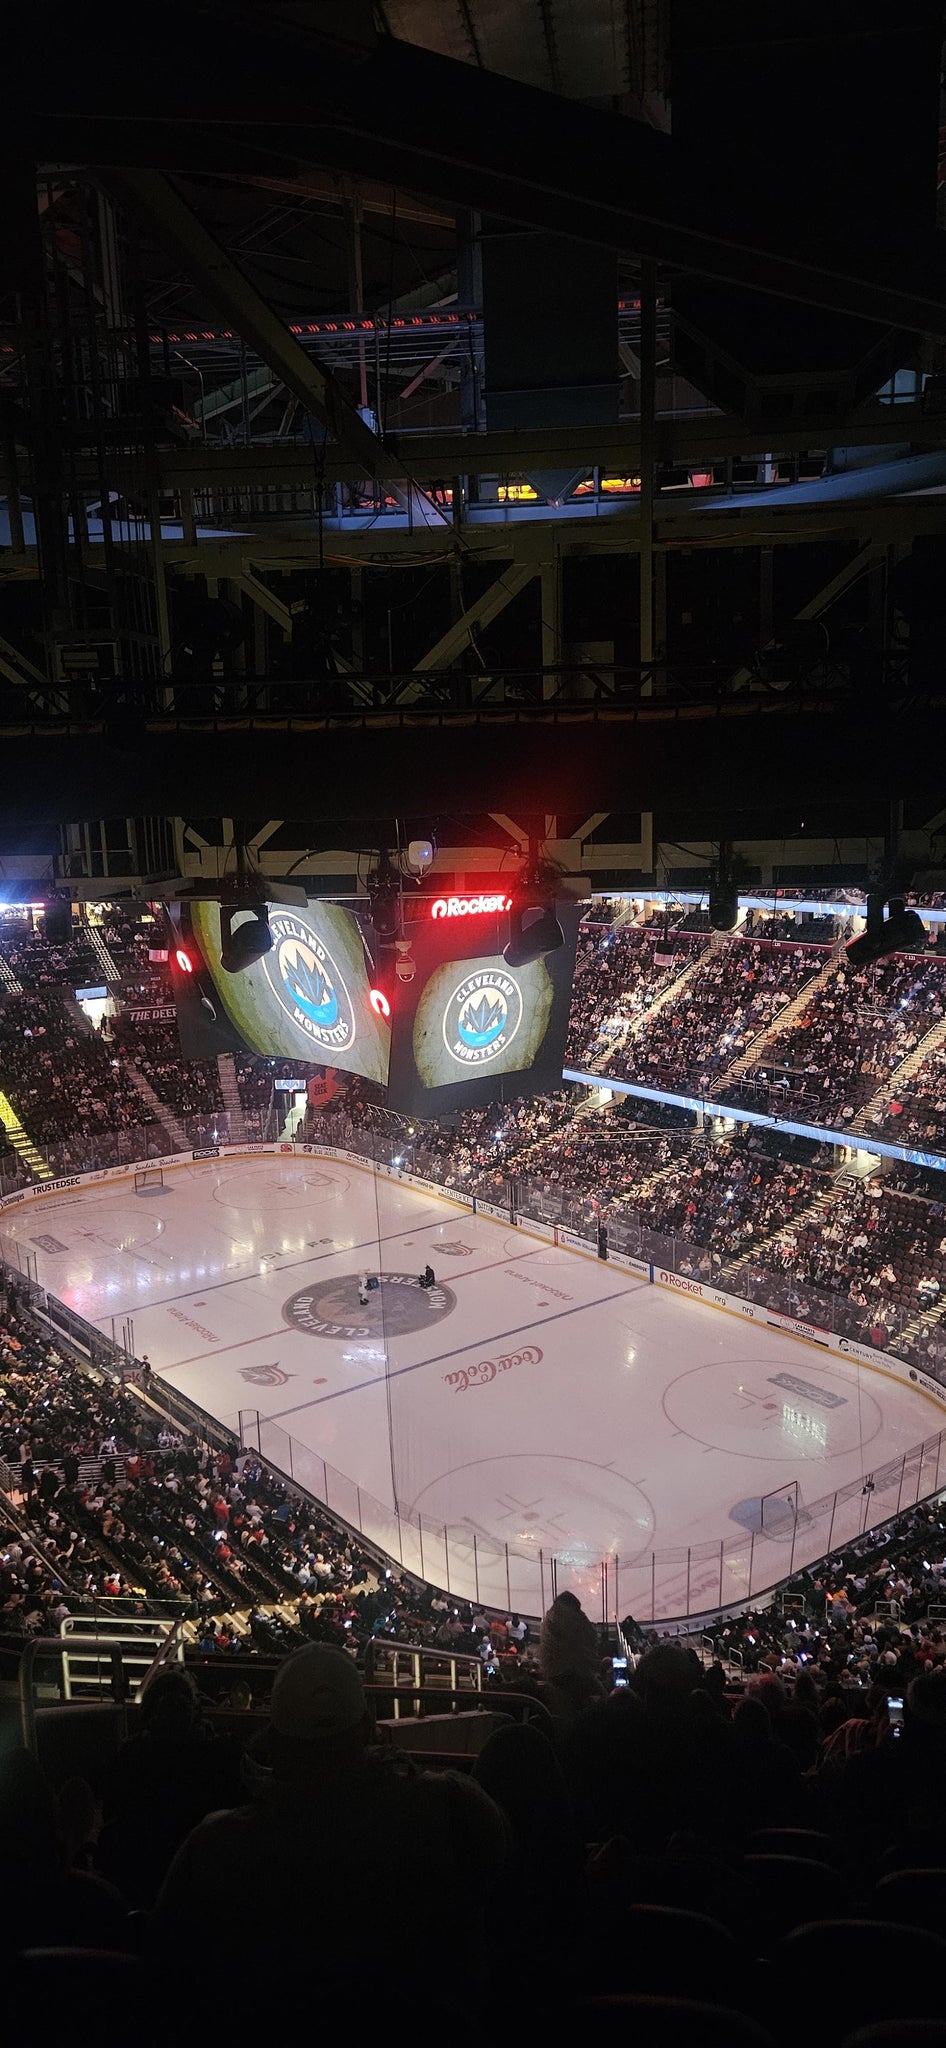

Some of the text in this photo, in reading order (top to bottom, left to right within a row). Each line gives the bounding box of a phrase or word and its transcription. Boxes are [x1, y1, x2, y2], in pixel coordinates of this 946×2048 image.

[271, 919, 326, 961] LEVELAND
[456, 974, 514, 1003] CLEVELAND
[130, 1010, 150, 1021] THE
[294, 1006, 349, 1044] MONSTERS
[453, 1033, 506, 1060] MONSTERS
[32, 1177, 81, 1196] TRUSTEDSEC
[670, 1274, 703, 1296] Rocket
[714, 1295, 726, 1306] nrg
[742, 1306, 754, 1316] nrg
[292, 1295, 370, 1336] CLEVELAND
[443, 1345, 544, 1395] Coca-Cola
